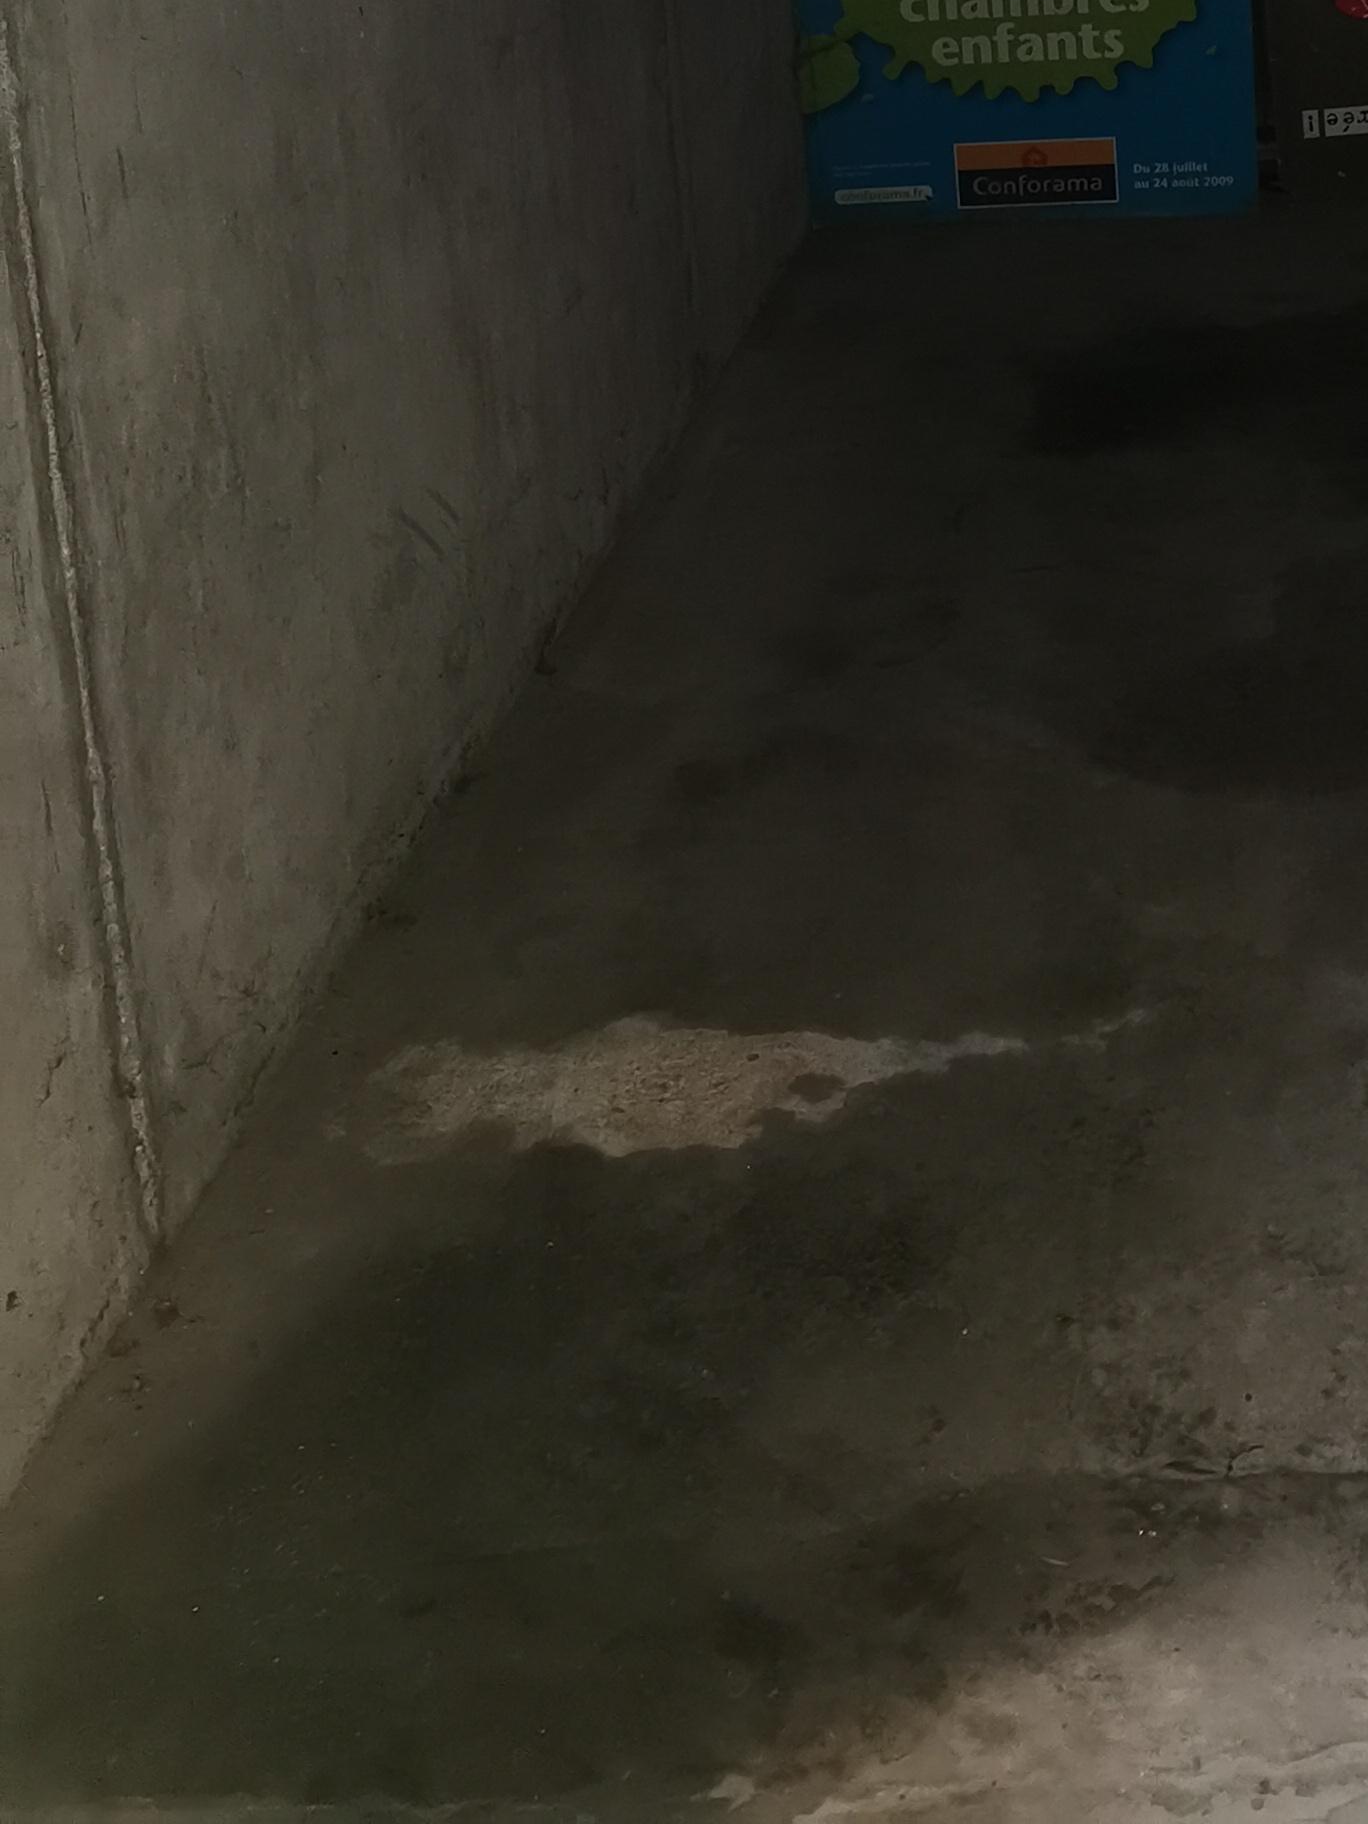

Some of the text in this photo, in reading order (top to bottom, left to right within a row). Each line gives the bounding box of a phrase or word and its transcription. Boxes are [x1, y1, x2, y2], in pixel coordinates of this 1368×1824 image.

[931, 21, 1126, 67] enfants
[1306, 114, 1315, 132] !
[1133, 160, 1208, 176] Du 28 juillet
[972, 174, 1103, 198] Conforama
[1133, 179, 1150, 189] au
[1152, 177, 1168, 189] 24
[1203, 176, 1235, 188] 2009
